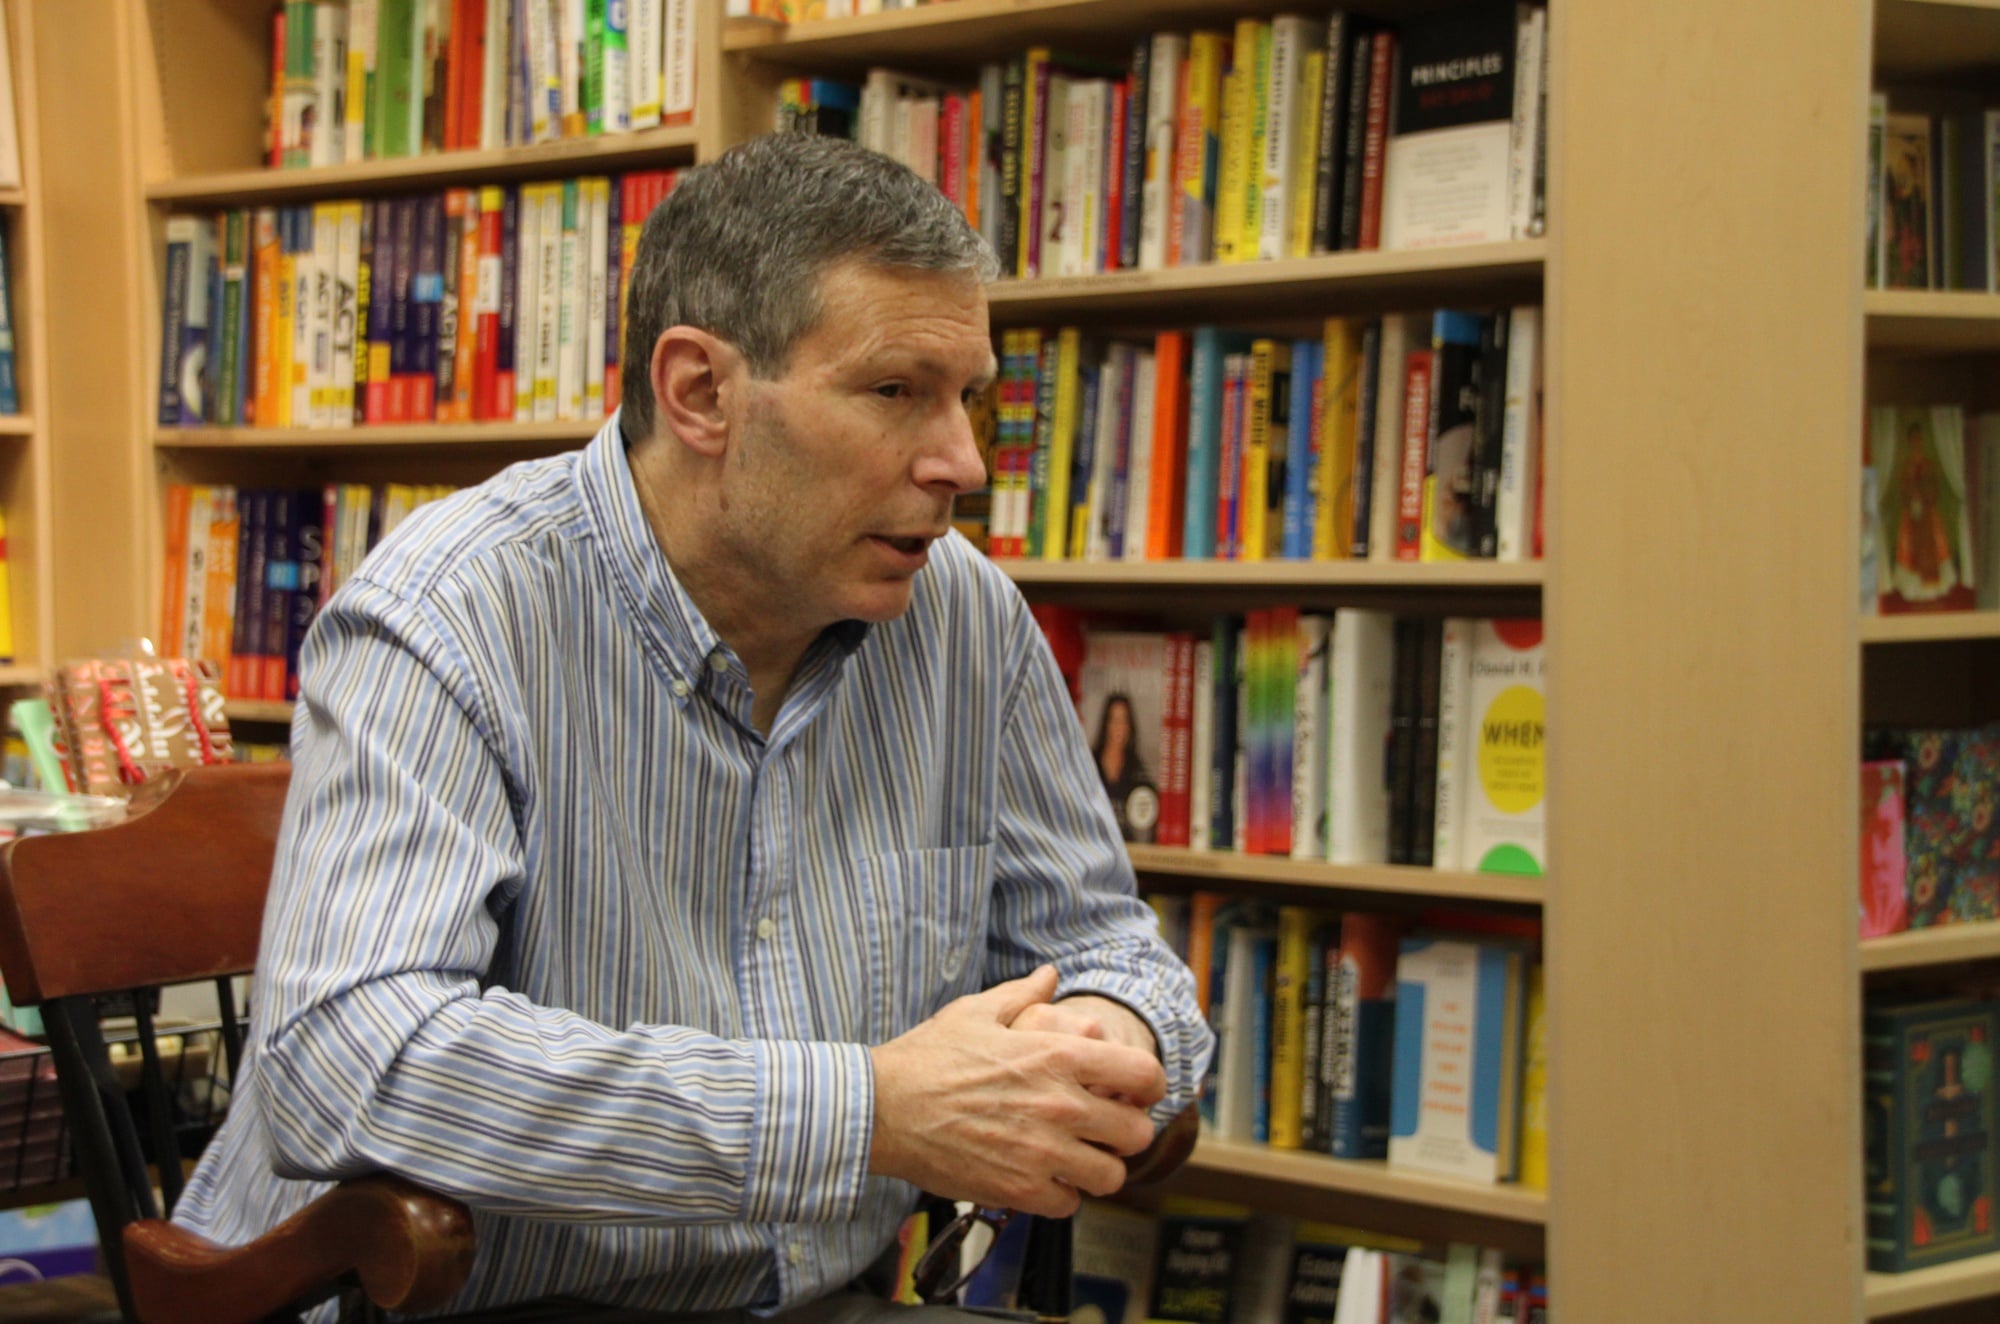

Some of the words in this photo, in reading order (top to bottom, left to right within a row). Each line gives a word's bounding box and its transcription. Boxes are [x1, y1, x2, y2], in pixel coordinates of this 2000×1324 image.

[1411, 52, 1503, 87] PRINCIPLES
[335, 280, 355, 360] ACT
[440, 292, 458, 358] ACT
